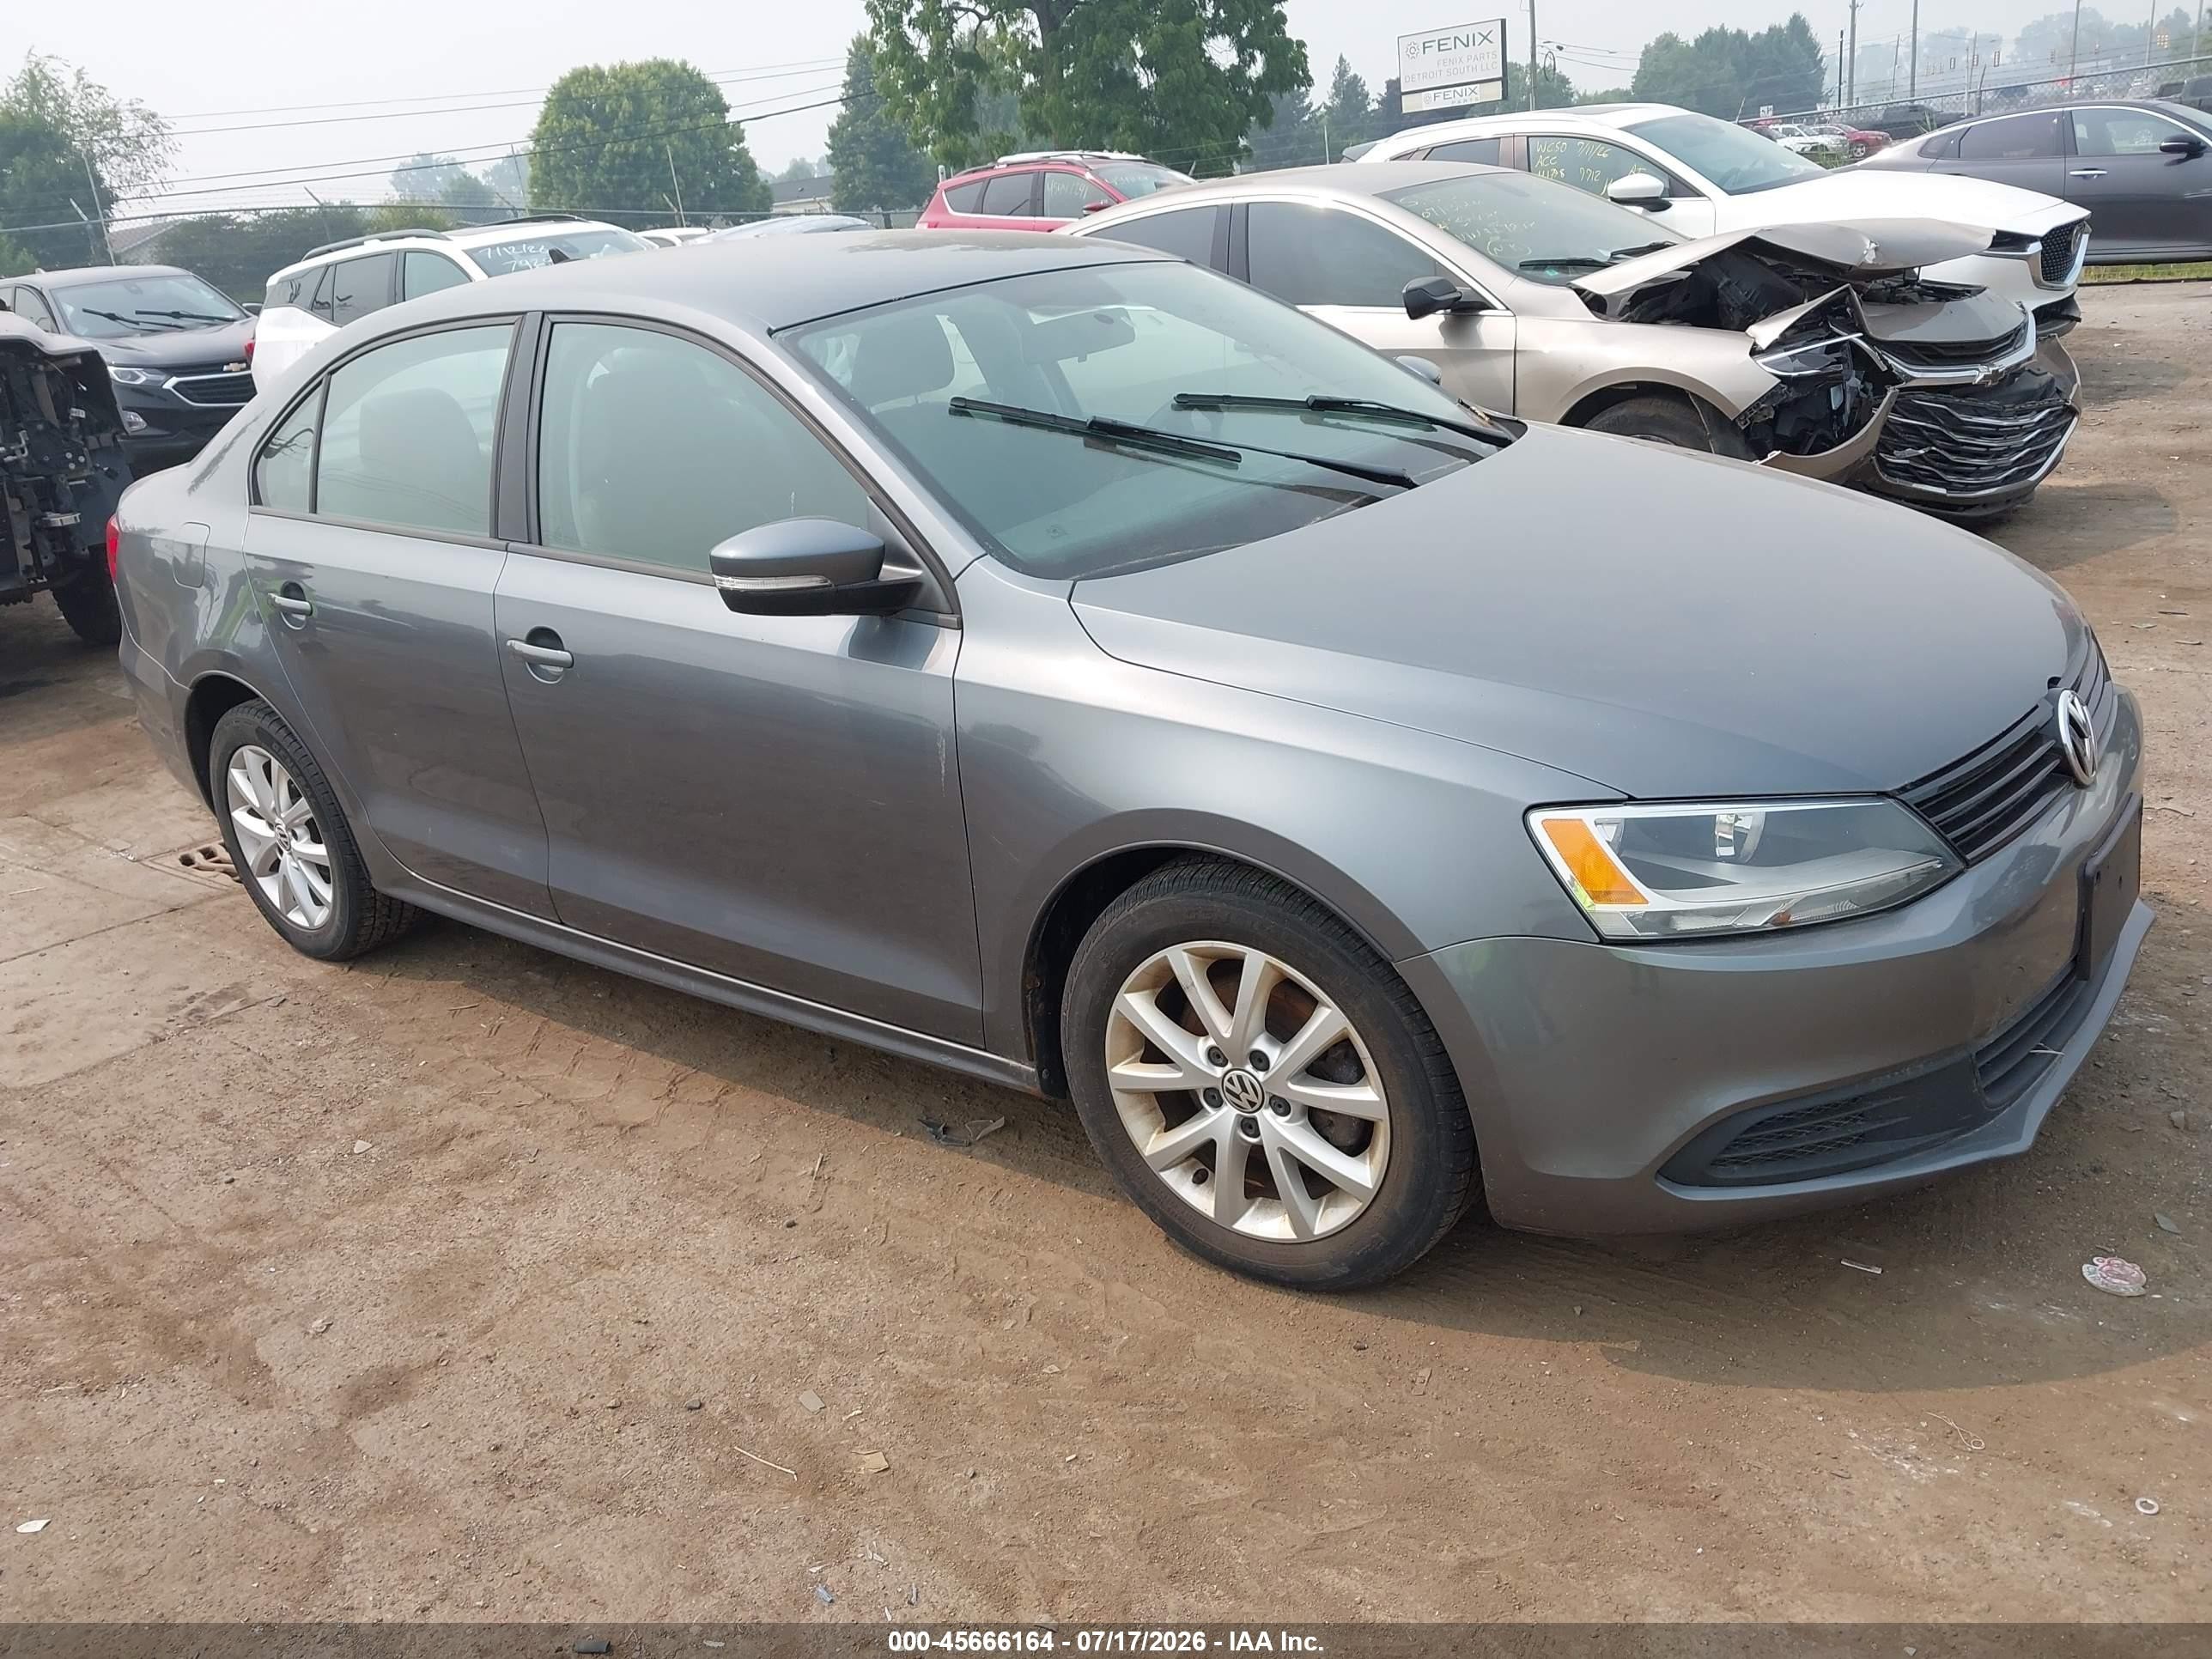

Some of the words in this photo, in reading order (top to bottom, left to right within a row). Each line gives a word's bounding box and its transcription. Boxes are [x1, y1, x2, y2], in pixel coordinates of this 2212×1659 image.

[1422, 29, 1494, 55] FENIX
[1437, 56, 1464, 68] FENIX
[1467, 50, 1498, 63] PARTS
[1404, 69, 1443, 83] DETROIT
[1446, 64, 1478, 76] SOUTH
[1480, 61, 1498, 70] LLC
[1433, 86, 1478, 101] FENIX
